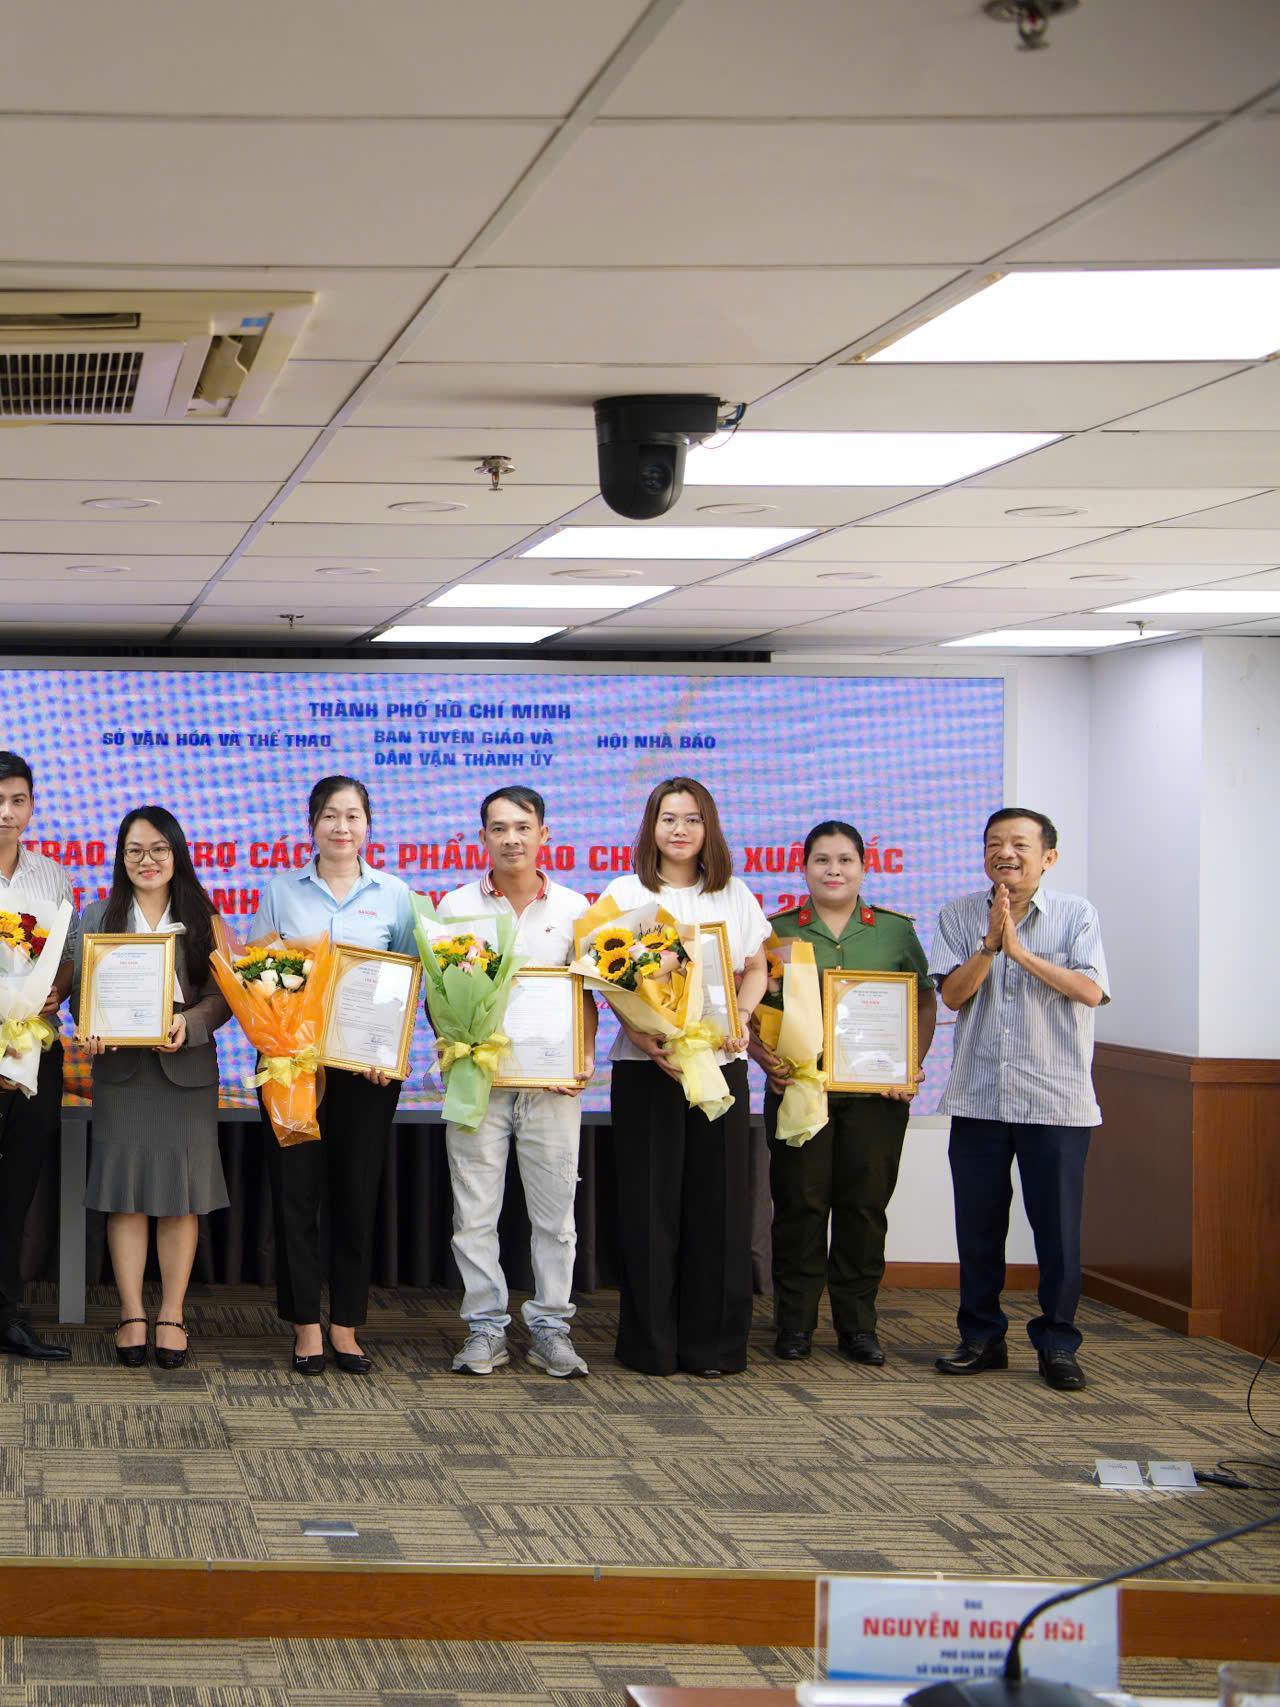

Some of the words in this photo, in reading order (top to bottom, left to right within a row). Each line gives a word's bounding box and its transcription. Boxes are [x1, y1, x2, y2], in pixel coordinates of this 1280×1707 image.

[309, 700, 378, 718] THÀNH
[386, 699, 428, 718] PHỐ
[435, 700, 462, 718] HỒ
[470, 701, 504, 719] CHÍ
[512, 704, 571, 719] MINH
[176, 730, 211, 747] HÓA
[219, 730, 240, 747] VÀ
[285, 734, 331, 747] THAO
[374, 730, 411, 743] BAN
[418, 729, 474, 744] TUYÊN
[482, 728, 524, 744] GIÁO
[530, 728, 554, 745] VÀ
[597, 732, 627, 750] HỘI
[634, 733, 672, 749] NHÀ
[679, 732, 716, 749] BÁO
[374, 750, 412, 766] DÂN
[463, 749, 523, 766] THÀNH
[186, 840, 238, 873] RỢ
[249, 835, 312, 869] CÁC
[533, 834, 575, 872] ÁO
[862, 836, 904, 875] ẮC
[863, 1612, 959, 1638] NGUYỄN
